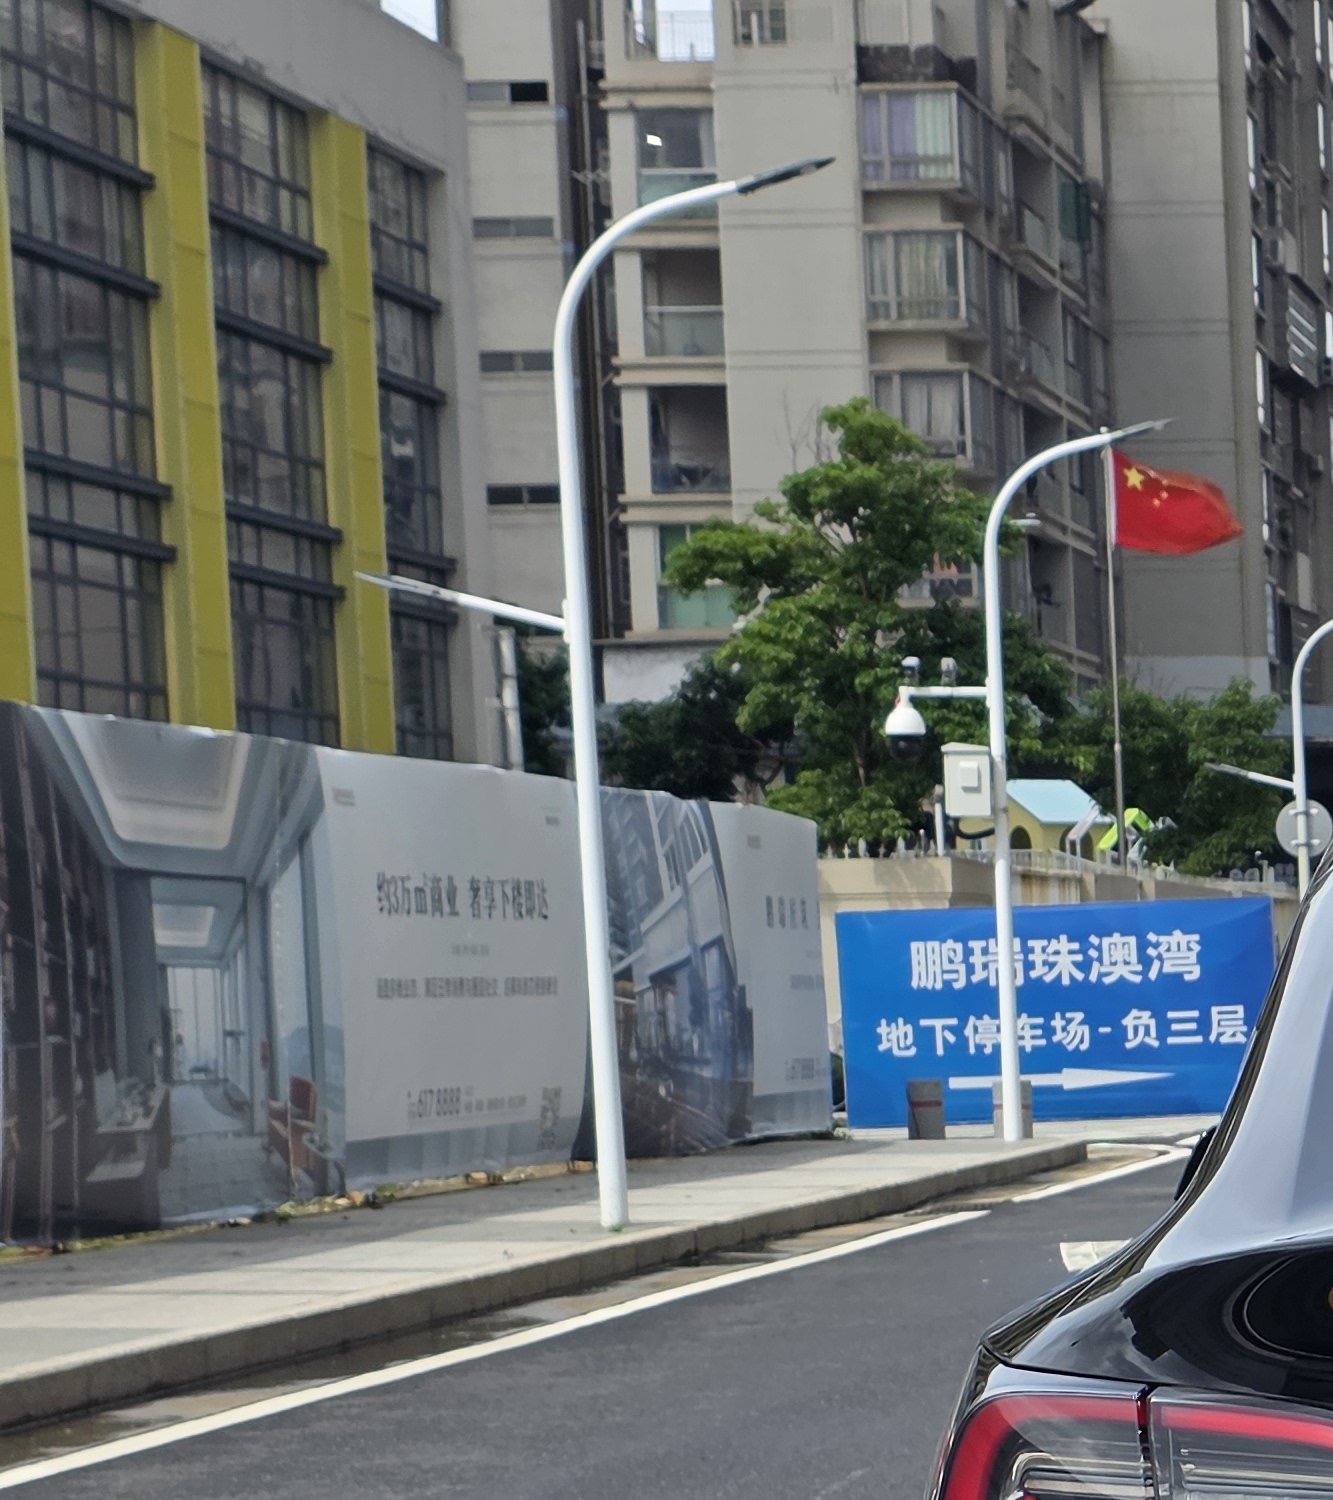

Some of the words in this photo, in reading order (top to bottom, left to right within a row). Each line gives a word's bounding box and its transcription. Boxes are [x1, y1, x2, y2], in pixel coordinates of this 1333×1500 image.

[910, 929, 1202, 991] 鹏瑞珠澳湾
